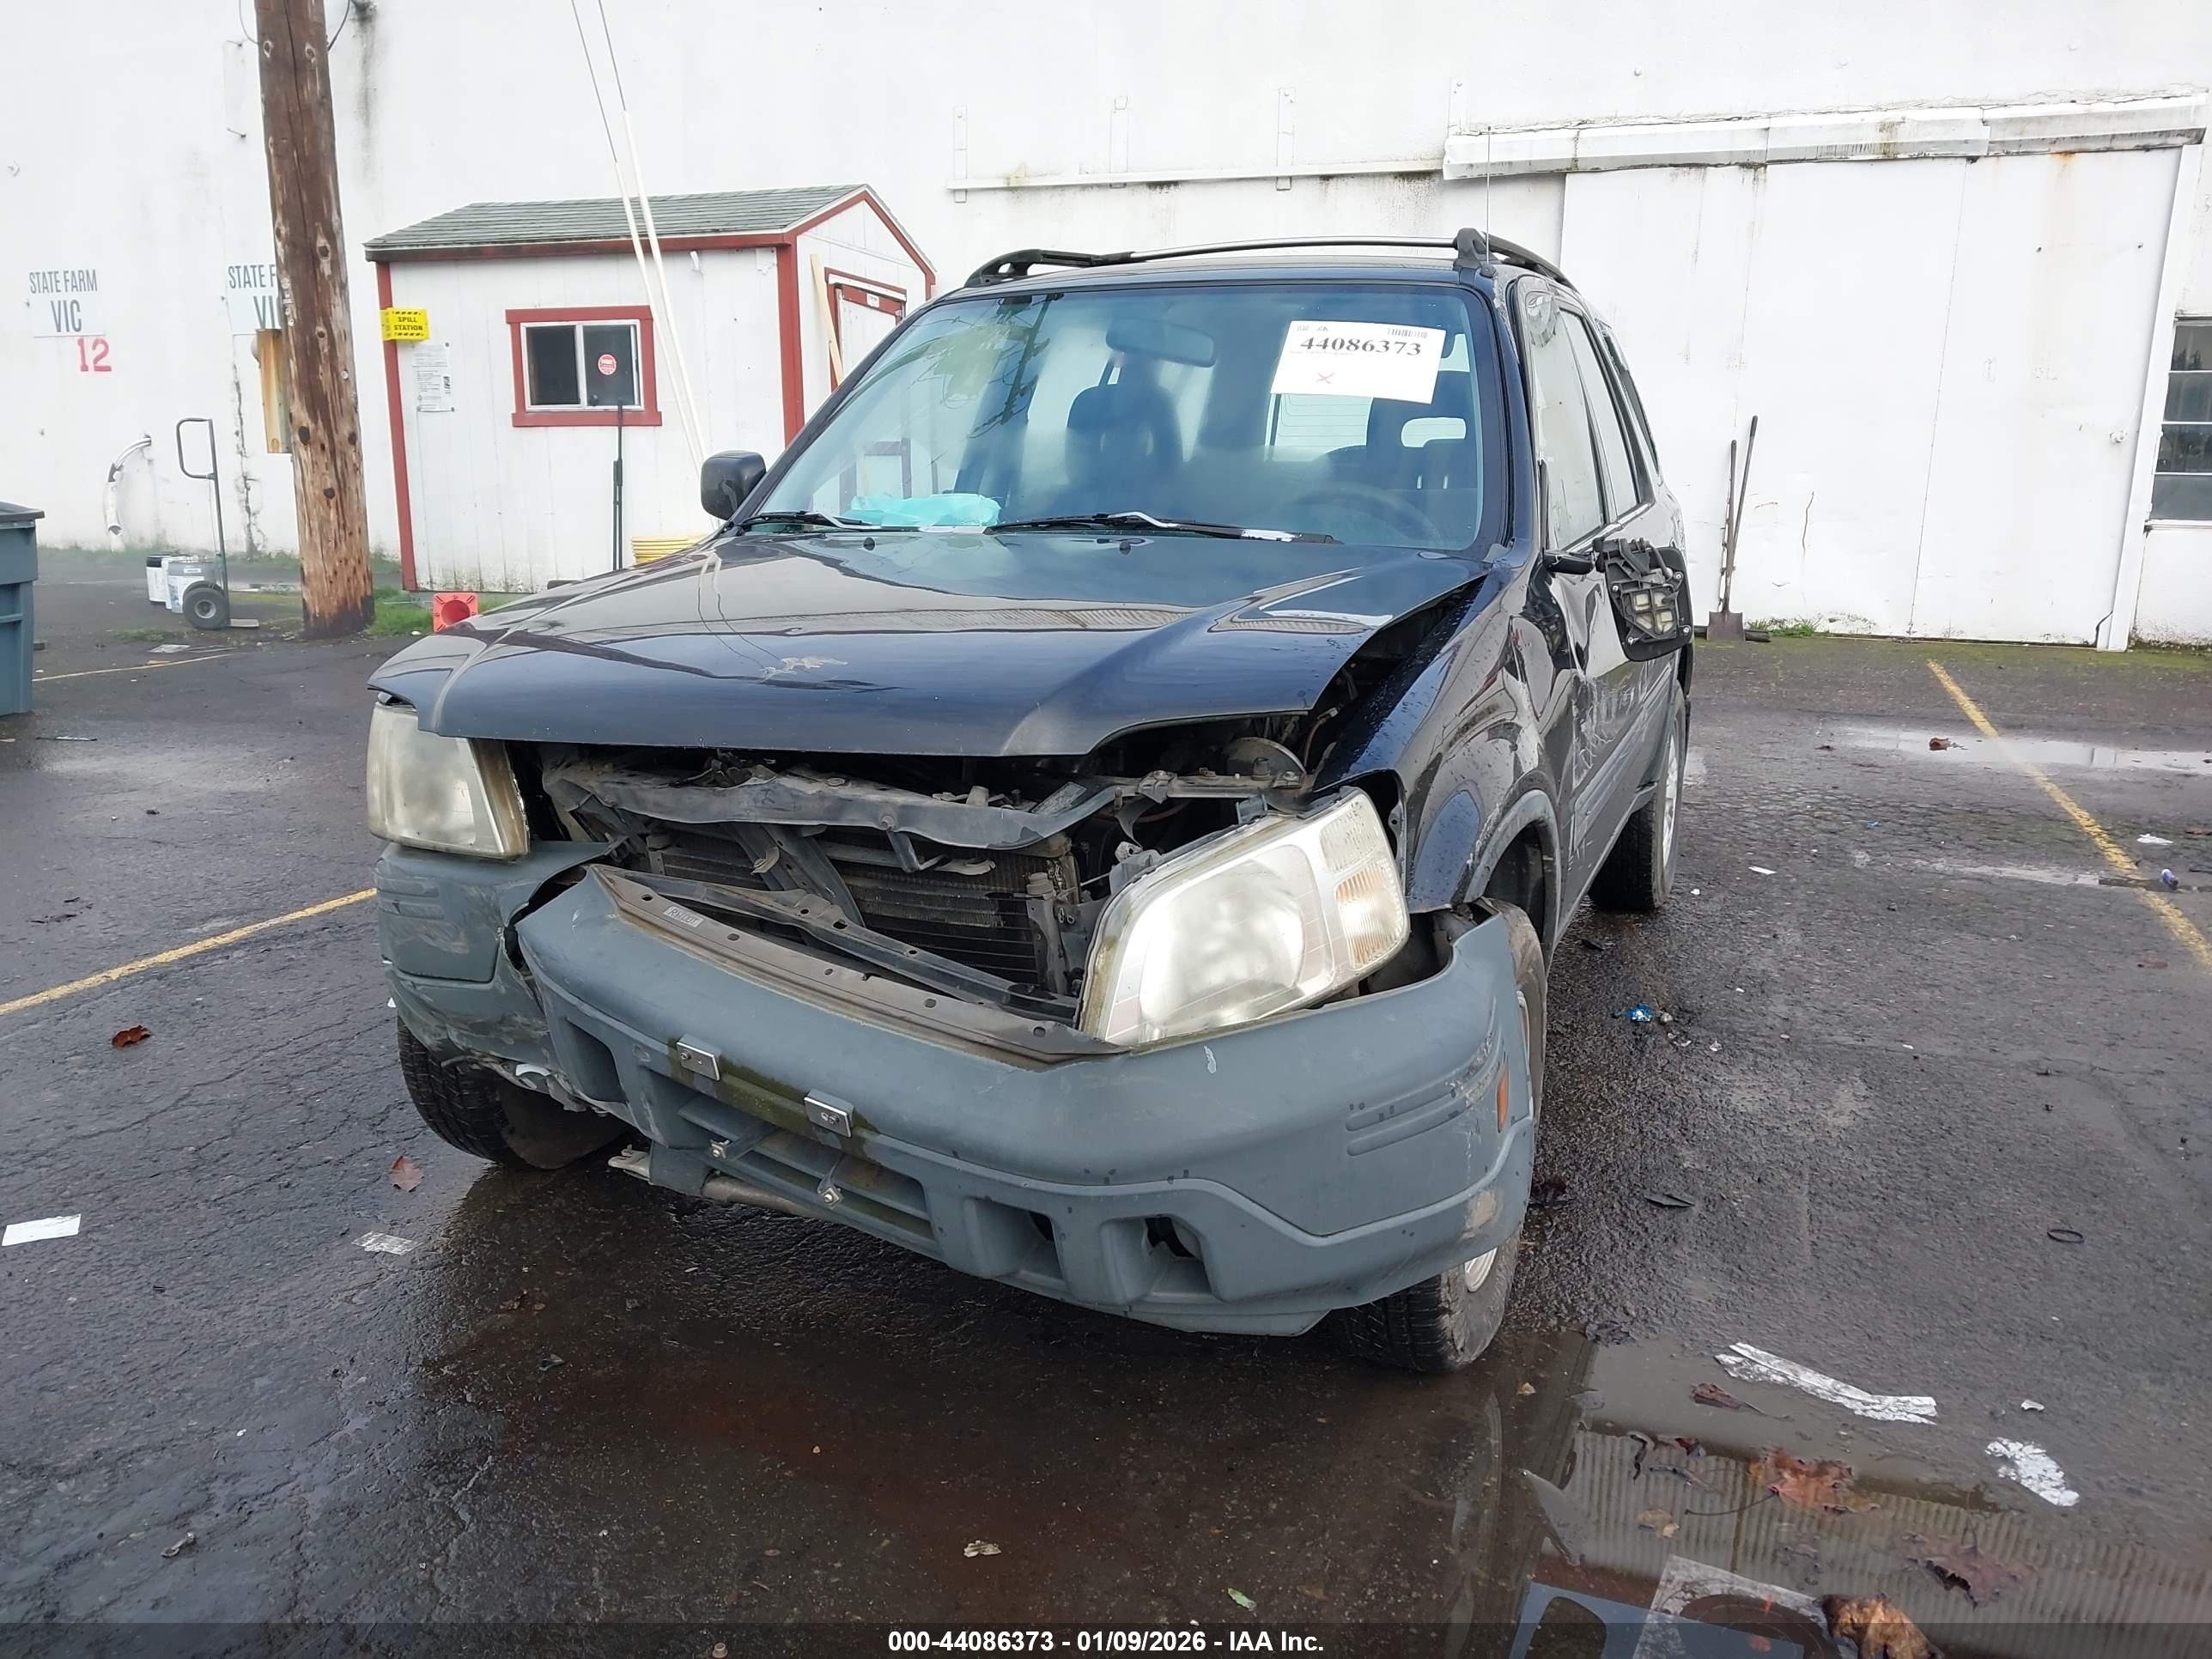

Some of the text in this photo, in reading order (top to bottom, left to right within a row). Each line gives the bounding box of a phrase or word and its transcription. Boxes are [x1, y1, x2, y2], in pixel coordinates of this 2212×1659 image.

[29, 270, 97, 294] STATE FARM
[228, 264, 266, 289] STATE
[50, 299, 82, 332] VIC
[252, 295, 276, 329] VI
[77, 336, 112, 372] 12
[1300, 337, 1421, 356] 44086373
